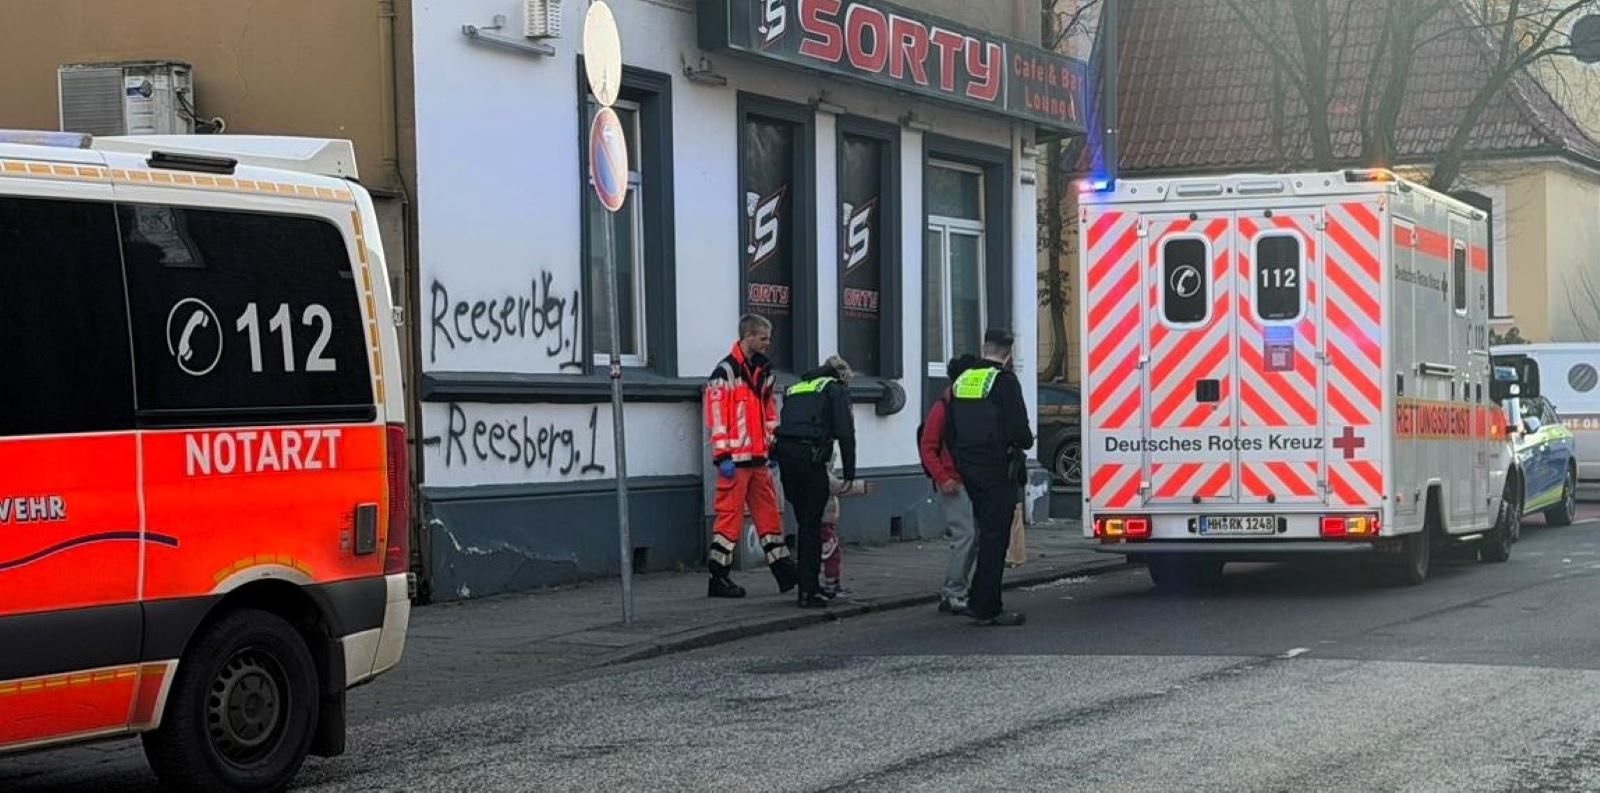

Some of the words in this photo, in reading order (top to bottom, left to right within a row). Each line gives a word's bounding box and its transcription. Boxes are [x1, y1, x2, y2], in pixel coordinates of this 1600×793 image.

[799, 0, 1001, 101] SORTY
[1048, 63, 1057, 87] &
[1260, 268, 1297, 288] 112
[236, 302, 337, 373] 112
[1396, 402, 1471, 434] RETTUNGSDIENST
[185, 429, 342, 477] NOTARZT
[1104, 436, 1201, 452] Deutsches
[1208, 435, 1262, 451] Rotes
[1268, 434, 1323, 450] Kreuz
[1246, 517, 1273, 530] 1248
